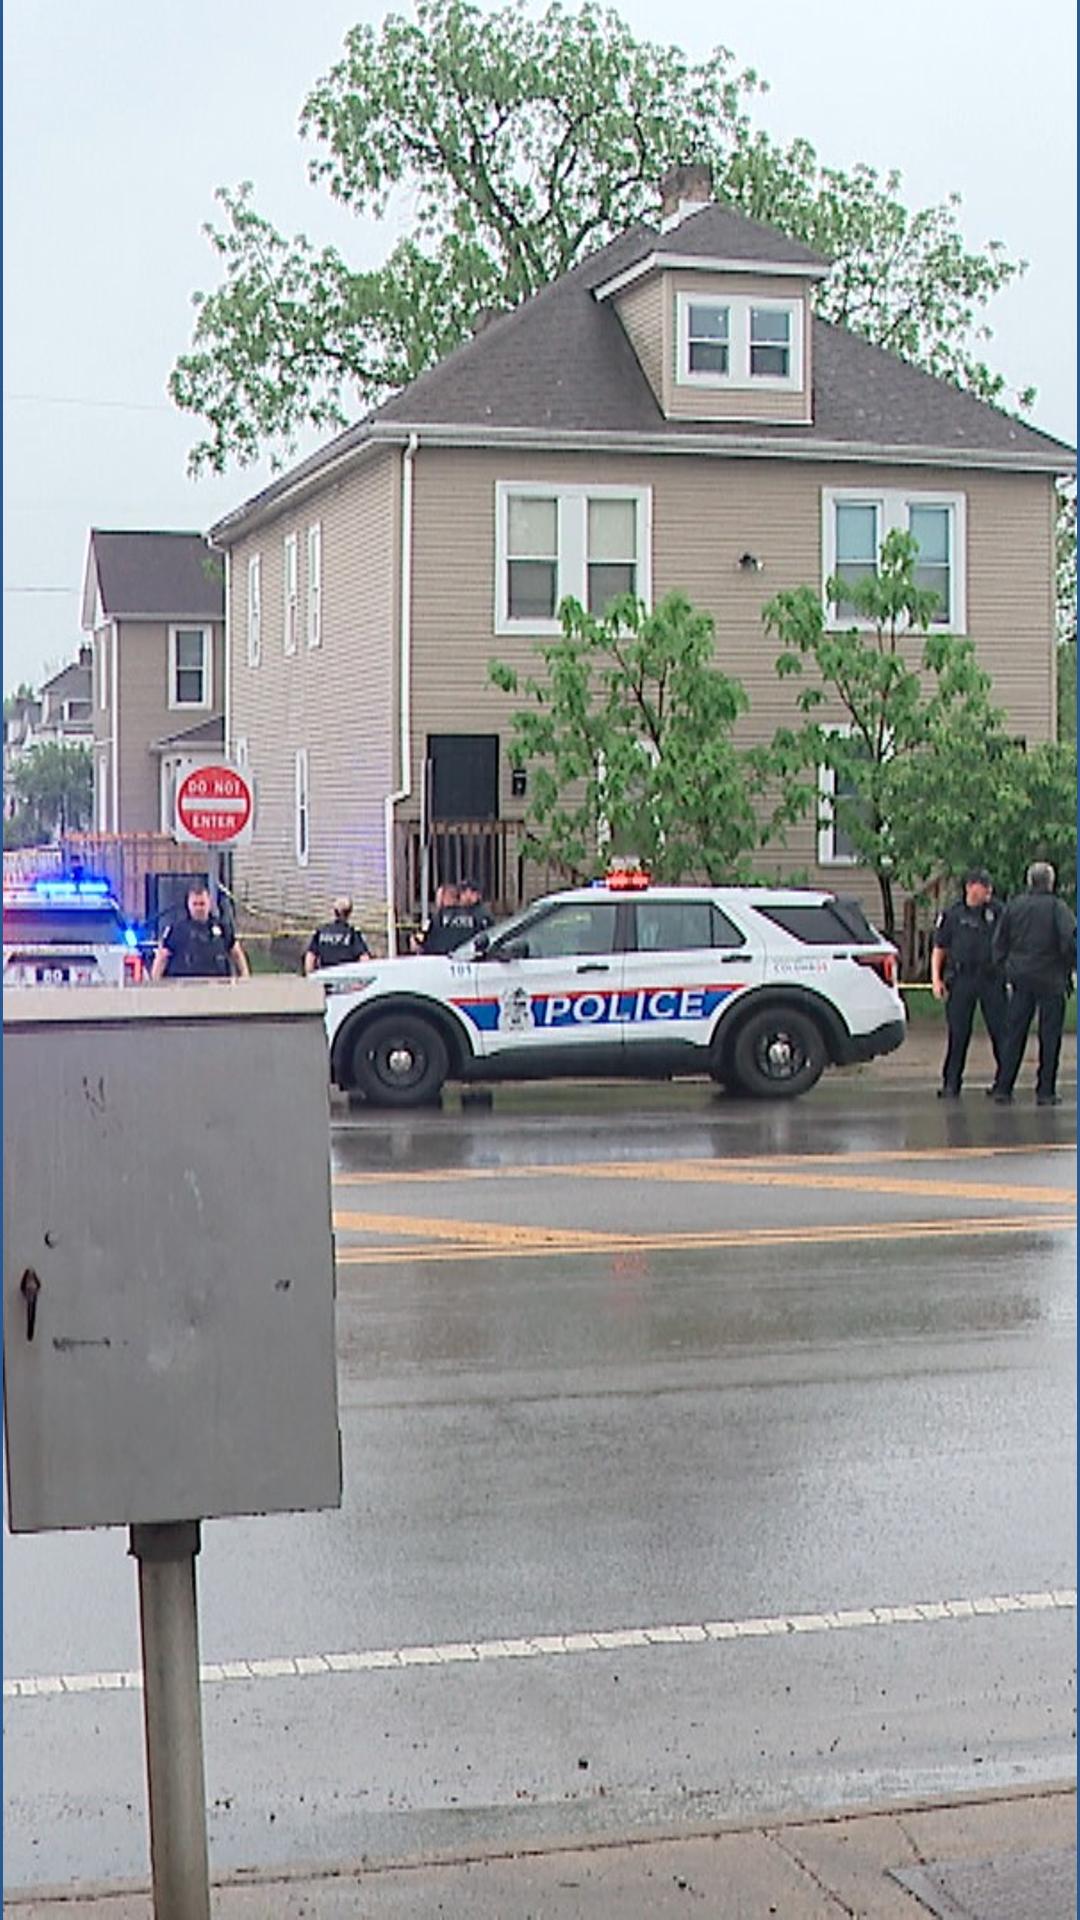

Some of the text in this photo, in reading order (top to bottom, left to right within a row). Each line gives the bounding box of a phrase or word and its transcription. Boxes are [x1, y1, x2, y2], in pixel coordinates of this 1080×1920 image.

[187, 780, 241, 796] DO NOT
[192, 814, 236, 829] ENTER
[449, 964, 472, 978] 101
[544, 988, 706, 1025] POLICE
